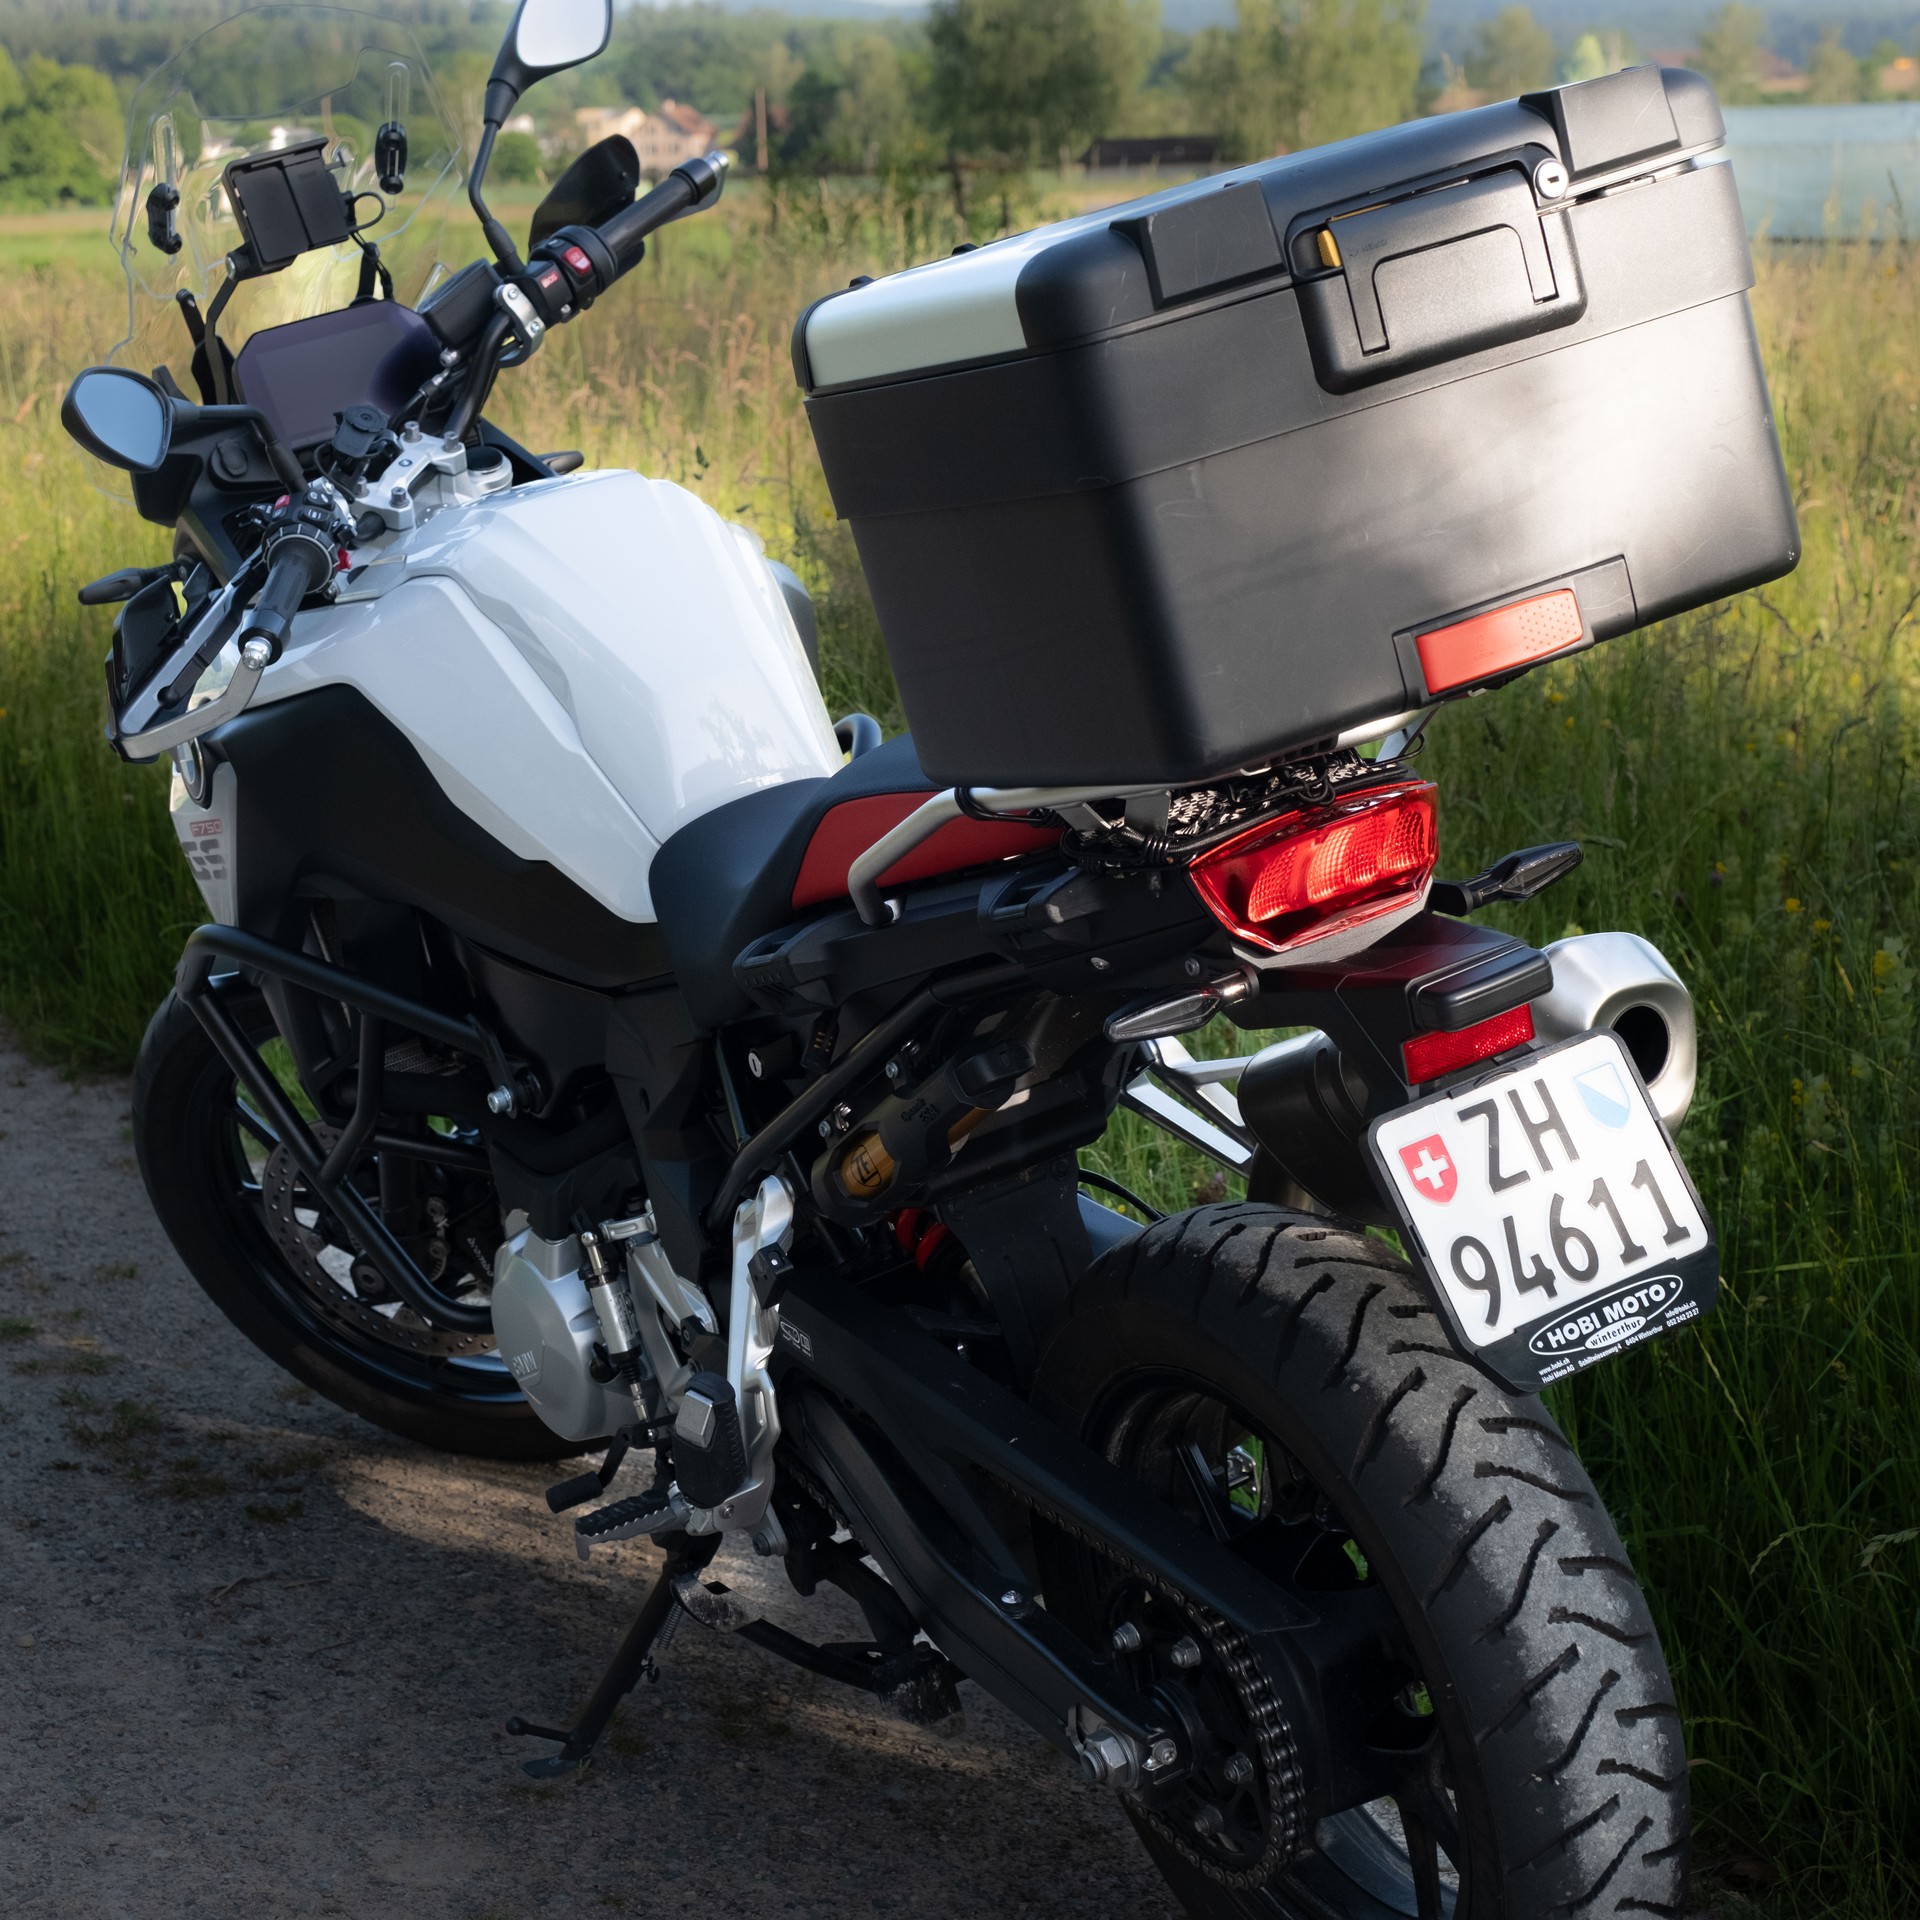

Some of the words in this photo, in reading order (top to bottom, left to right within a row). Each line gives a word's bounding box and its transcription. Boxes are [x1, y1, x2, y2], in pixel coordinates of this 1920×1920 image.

[191, 820, 222, 836] F750
[181, 839, 229, 880] GS
[1457, 1078, 1580, 1194] ZH
[1450, 1158, 1691, 1329] 94611
[1546, 1312, 1601, 1349] HOBI
[1602, 1284, 1666, 1323] MOTO
[1665, 1300, 1697, 1318] info@hobi.ch
[1541, 1372, 1554, 1384] Hobi
[1553, 1368, 1567, 1379] Moto
[1566, 1364, 1575, 1374] AG
[1625, 1335, 1639, 1346] 8404
[1638, 1325, 1664, 1340] Winterthur
[1666, 1318, 1678, 1327] 052
[1676, 1314, 1687, 1323] 242
[1685, 1310, 1693, 1319] 23
[1692, 1307, 1700, 1316] 27
[1590, 1319, 1641, 1347] winterthur
[512, 1350, 538, 1375] BMW
[1538, 1357, 1571, 1375] www.hobi.ch
